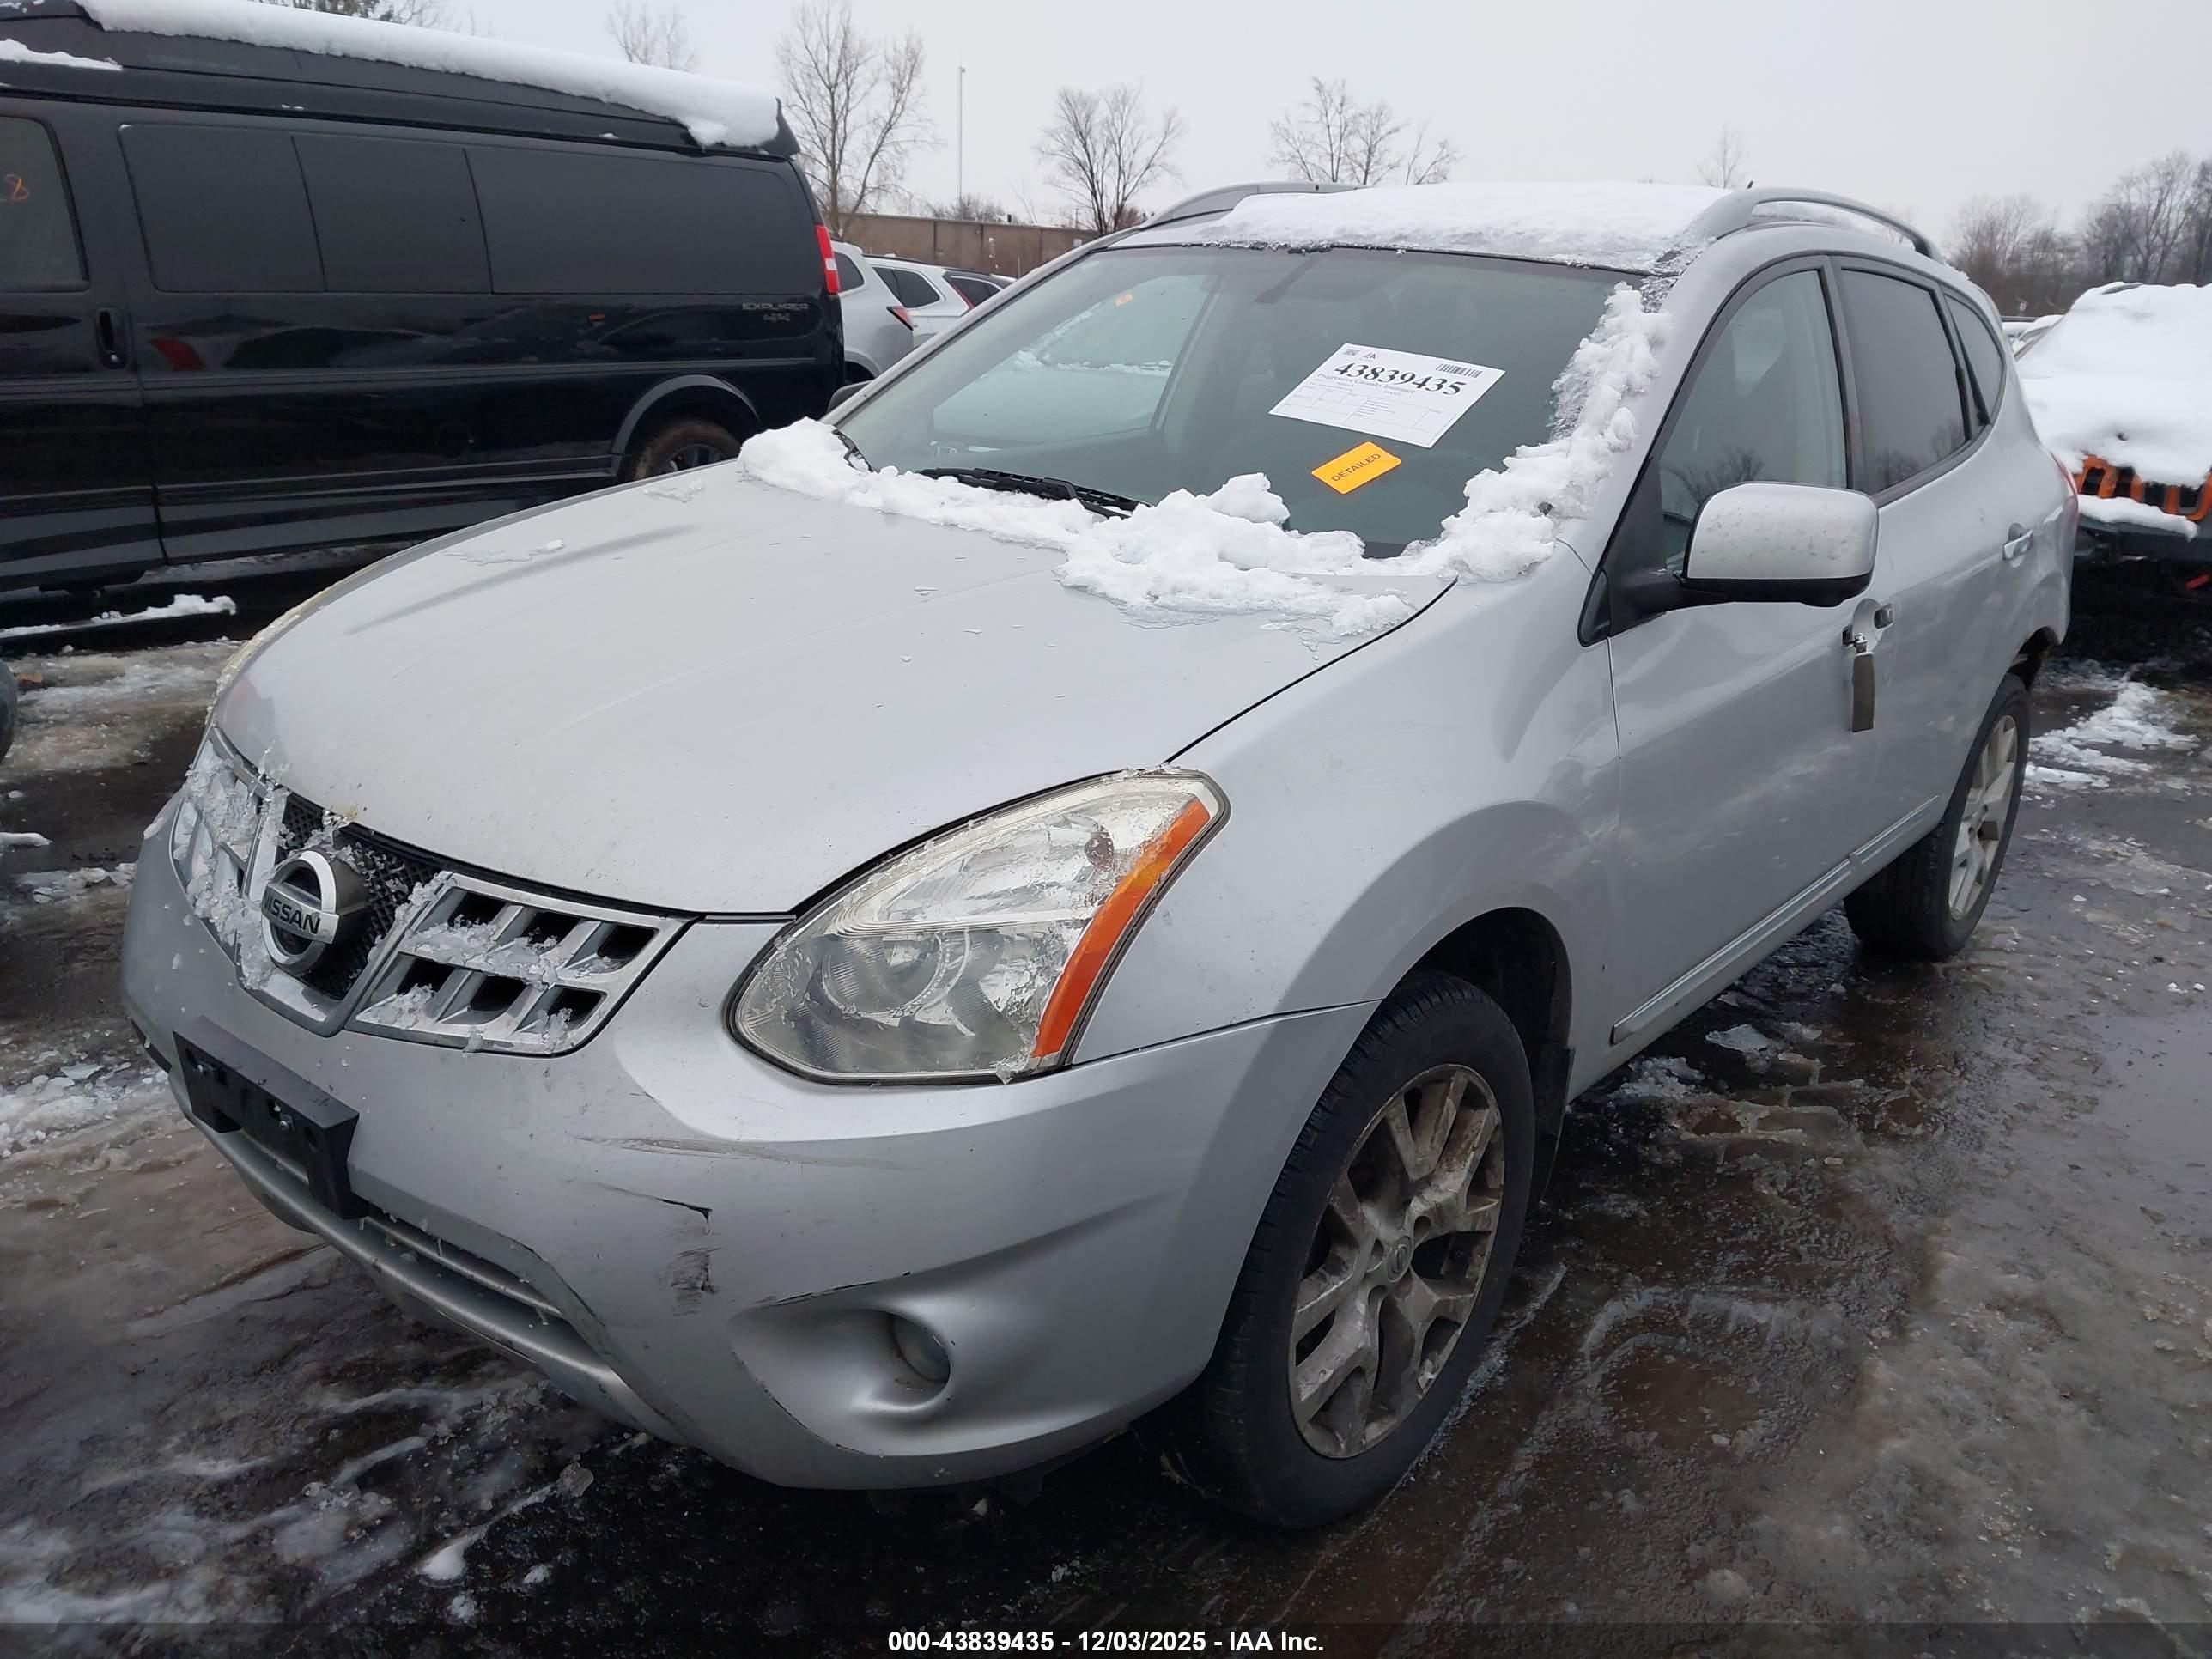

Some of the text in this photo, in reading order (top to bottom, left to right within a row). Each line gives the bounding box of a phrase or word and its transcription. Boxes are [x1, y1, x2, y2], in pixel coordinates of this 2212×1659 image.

[1334, 362, 1468, 396] 43839435
[1331, 453, 1382, 482] DETAILED
[264, 894, 321, 935] NISSAN
